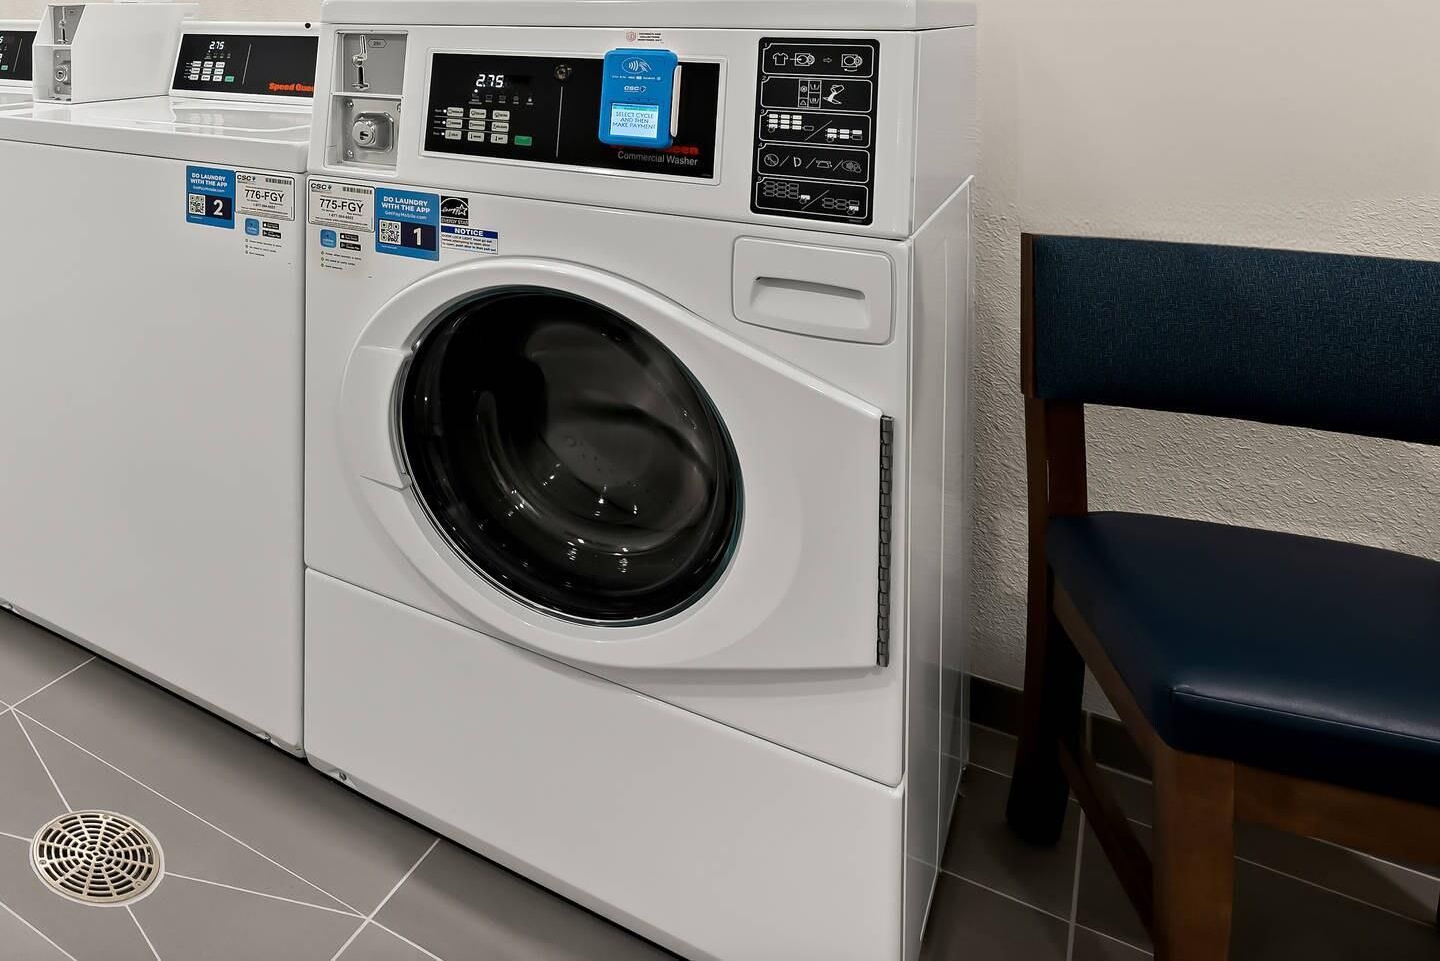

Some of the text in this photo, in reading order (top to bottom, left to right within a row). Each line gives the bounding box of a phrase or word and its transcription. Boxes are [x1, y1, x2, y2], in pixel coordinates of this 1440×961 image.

[269, 83, 295, 91] Speed
[476, 74, 505, 88] 2.75
[618, 151, 698, 165] Commercial Washer
[245, 189, 284, 202] 776-FGY
[395, 197, 428, 206] LAUNDRY
[213, 199, 224, 216] 2
[320, 198, 364, 213] 775-FGY
[385, 211, 427, 219] GetPayMobile.com
[413, 227, 422, 246] 1
[454, 228, 484, 237] NOTICE
